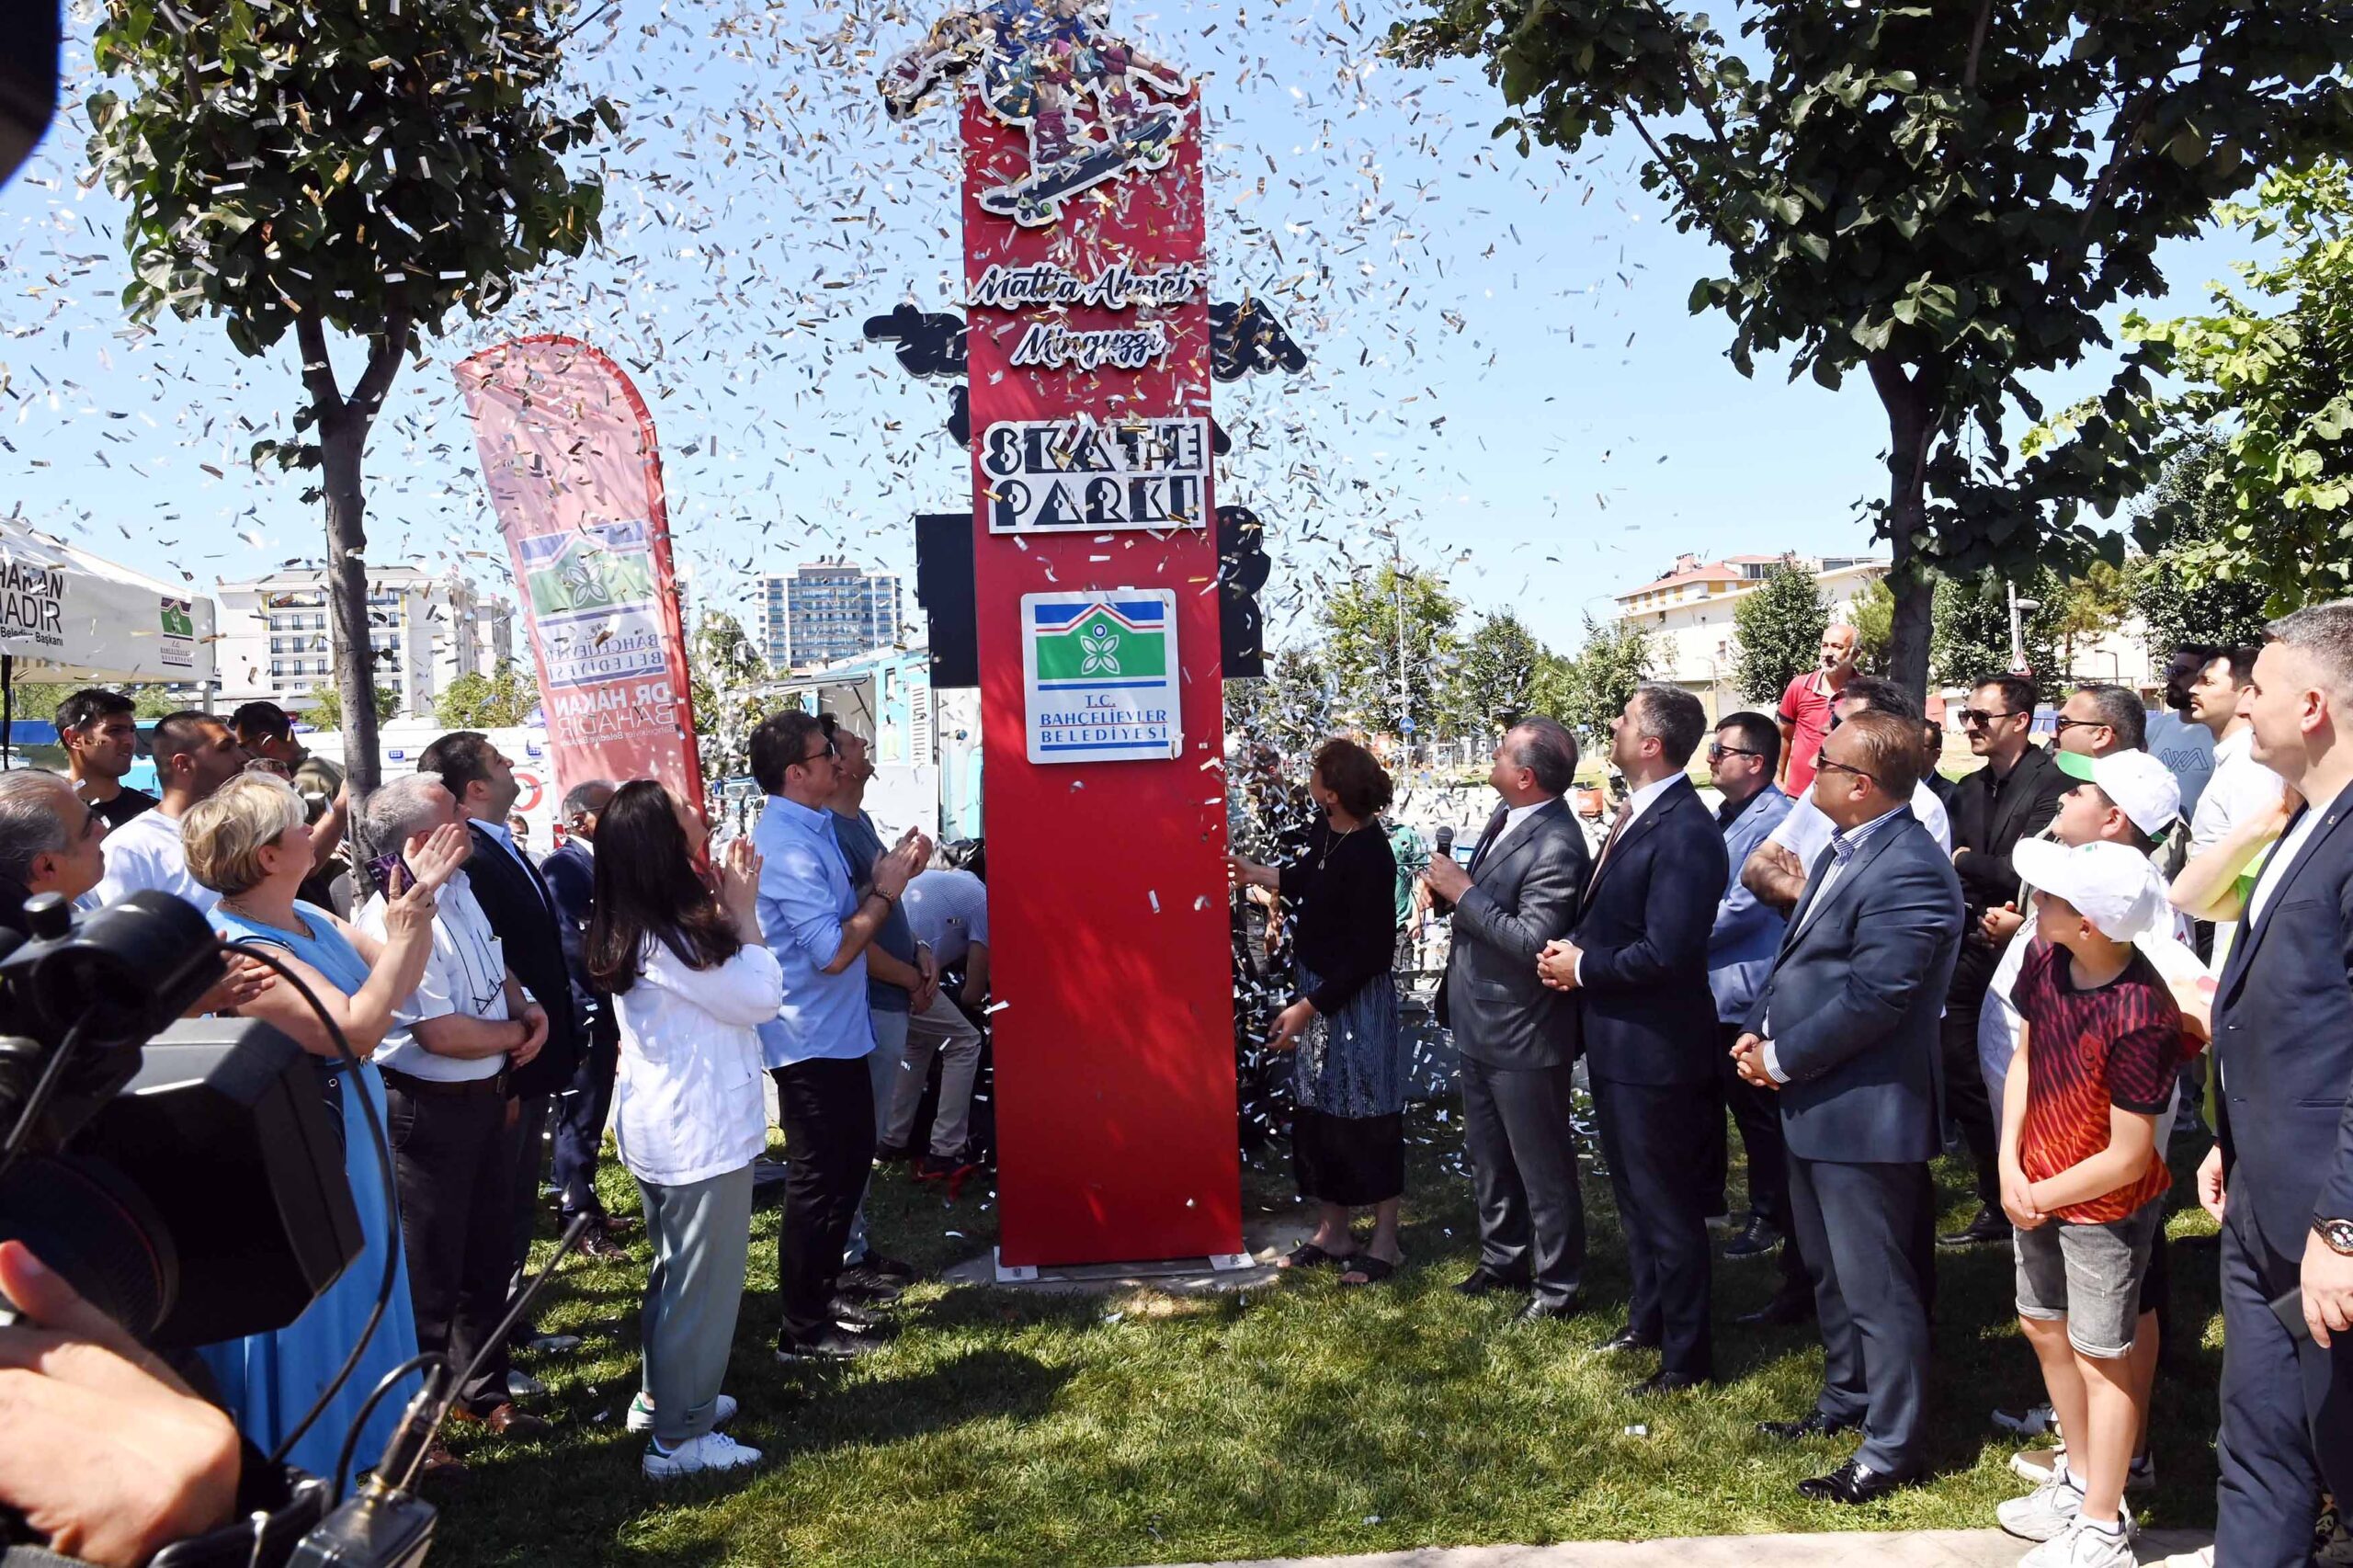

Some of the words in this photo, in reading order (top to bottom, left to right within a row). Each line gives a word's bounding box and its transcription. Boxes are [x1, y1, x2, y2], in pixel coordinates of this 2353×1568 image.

[972, 264, 1083, 305] Mattia
[986, 424, 1203, 475] SKATE
[995, 475, 1199, 526] PARKI
[0, 591, 63, 634] ADIR
[1040, 709, 1167, 726] BAHÇELİEVLER
[1085, 694, 1117, 707] T.C.
[1041, 724, 1167, 743] BELEDİYESİ
